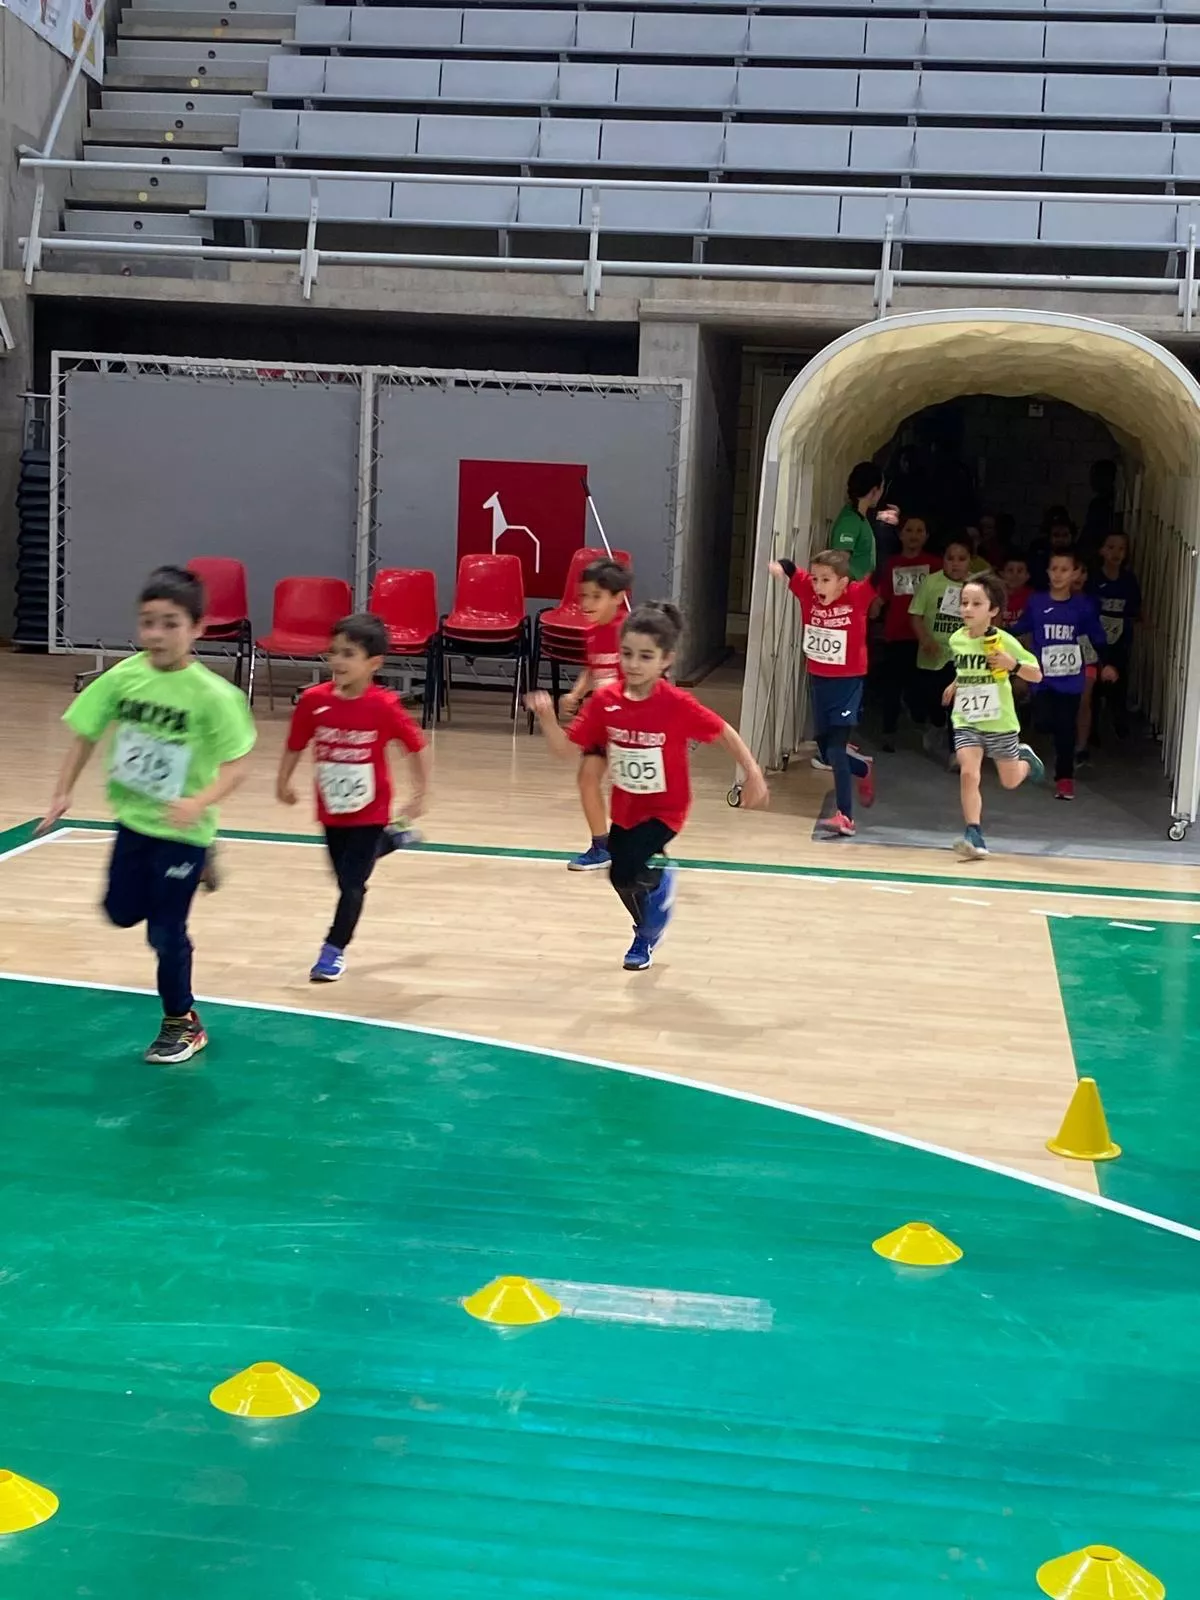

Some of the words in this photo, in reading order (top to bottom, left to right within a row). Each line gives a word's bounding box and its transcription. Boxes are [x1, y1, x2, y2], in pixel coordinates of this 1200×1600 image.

[807, 635, 842, 655] 2109
[1049, 652, 1077, 668] 220
[961, 695, 990, 712] 217
